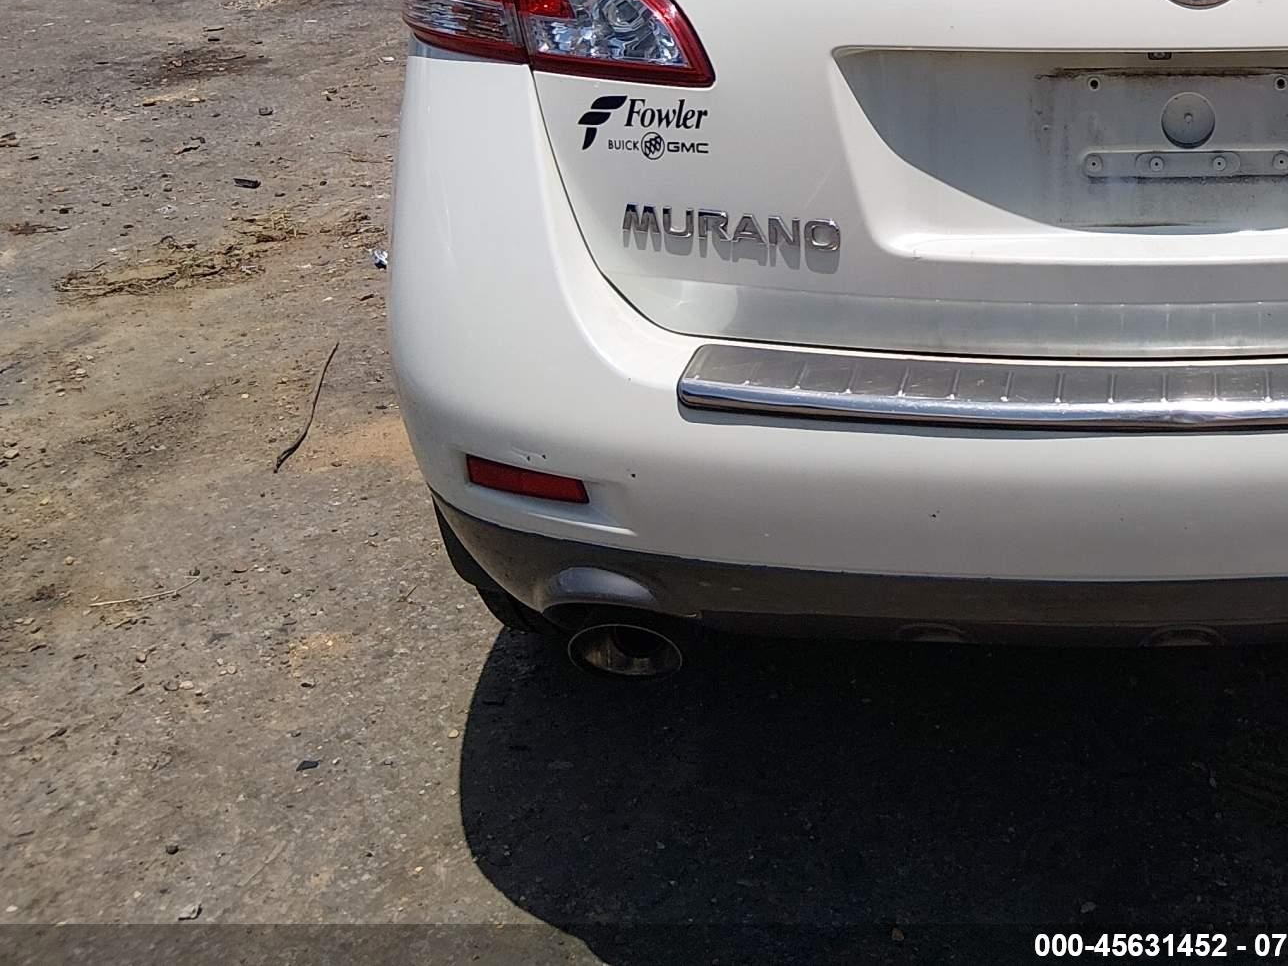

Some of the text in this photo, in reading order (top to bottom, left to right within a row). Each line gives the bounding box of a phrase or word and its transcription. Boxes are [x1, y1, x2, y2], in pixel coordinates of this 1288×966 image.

[624, 98, 708, 129] Fowler
[608, 139, 709, 153] BUICK GMC
[622, 202, 841, 251] MURANO
